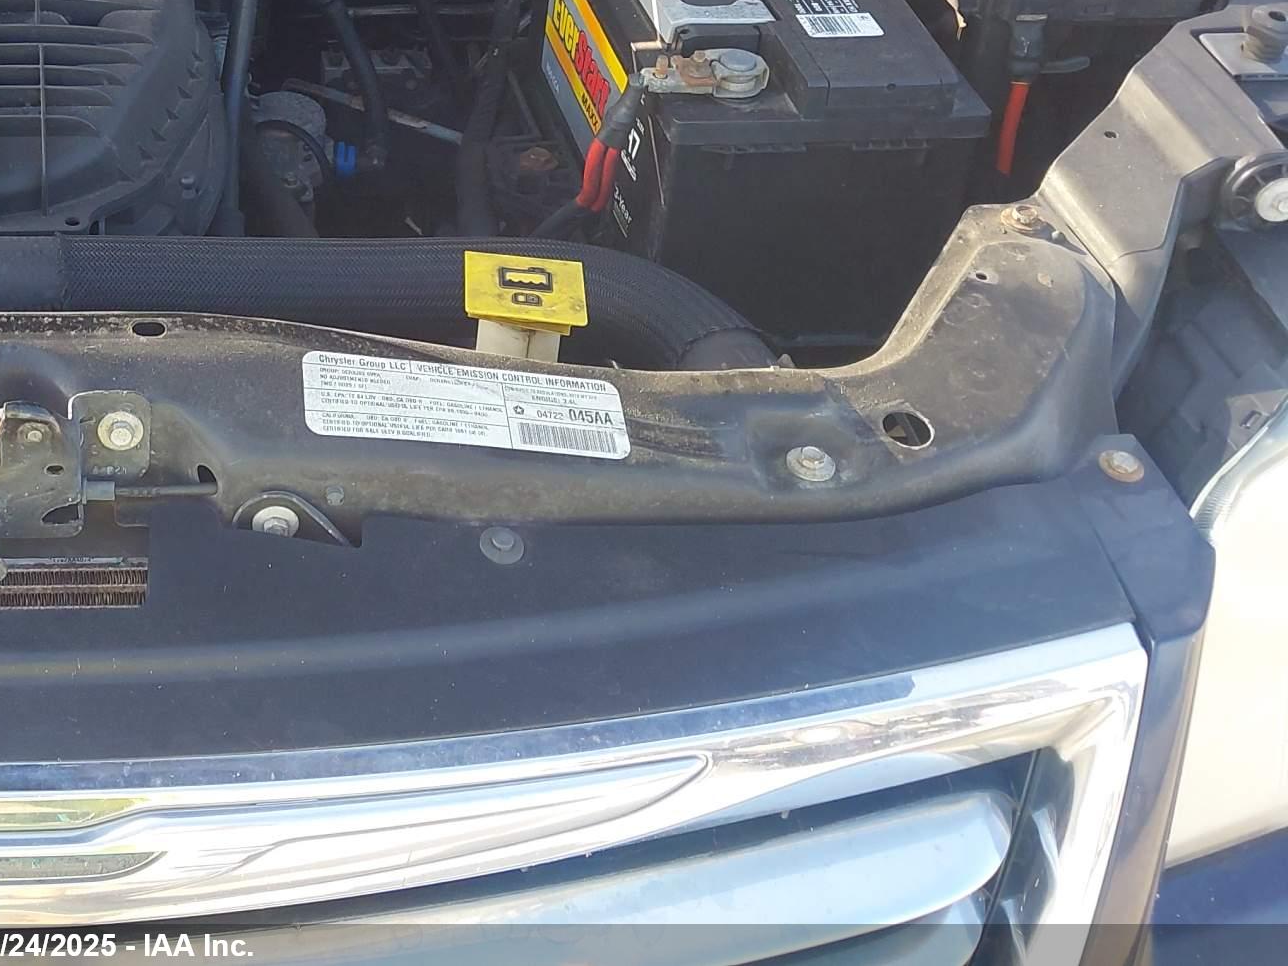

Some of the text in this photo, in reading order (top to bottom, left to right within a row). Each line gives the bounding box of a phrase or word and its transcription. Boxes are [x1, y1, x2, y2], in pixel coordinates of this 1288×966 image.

[581, 92, 599, 134] MAXX
[318, 354, 355, 367] Chrysler
[358, 358, 386, 370] Group
[389, 360, 406, 370] LLC
[416, 363, 454, 376] VEHICLE
[456, 368, 500, 381] EMISSION
[502, 373, 543, 385] CONTROL
[545, 377, 607, 392] INFORMATION
[536, 408, 613, 425] 04722 045AA
